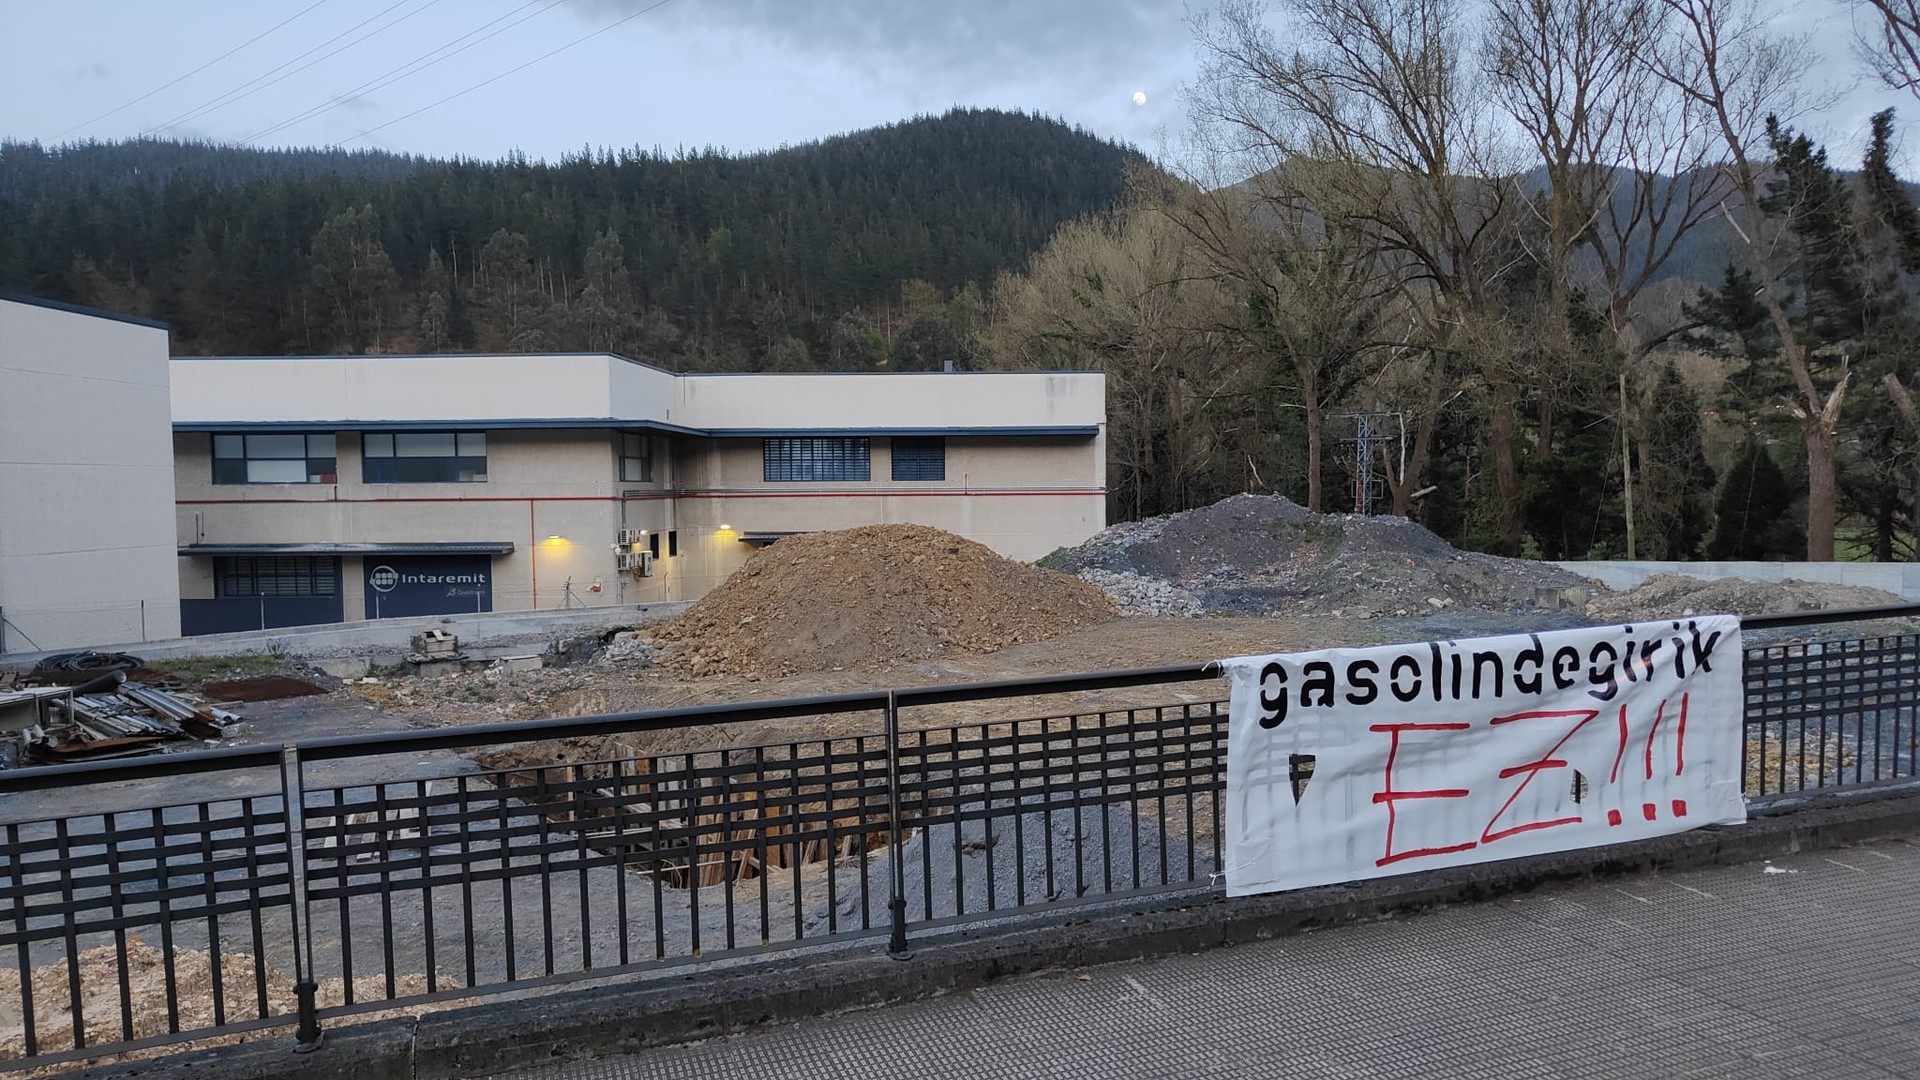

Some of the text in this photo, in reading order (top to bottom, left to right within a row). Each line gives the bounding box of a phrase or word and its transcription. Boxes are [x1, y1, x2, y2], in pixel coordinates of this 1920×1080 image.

[402, 573, 486, 583] Intaremit
[1259, 620, 1721, 729] gasolindegirik
[1370, 692, 1688, 867] EZ!!!
